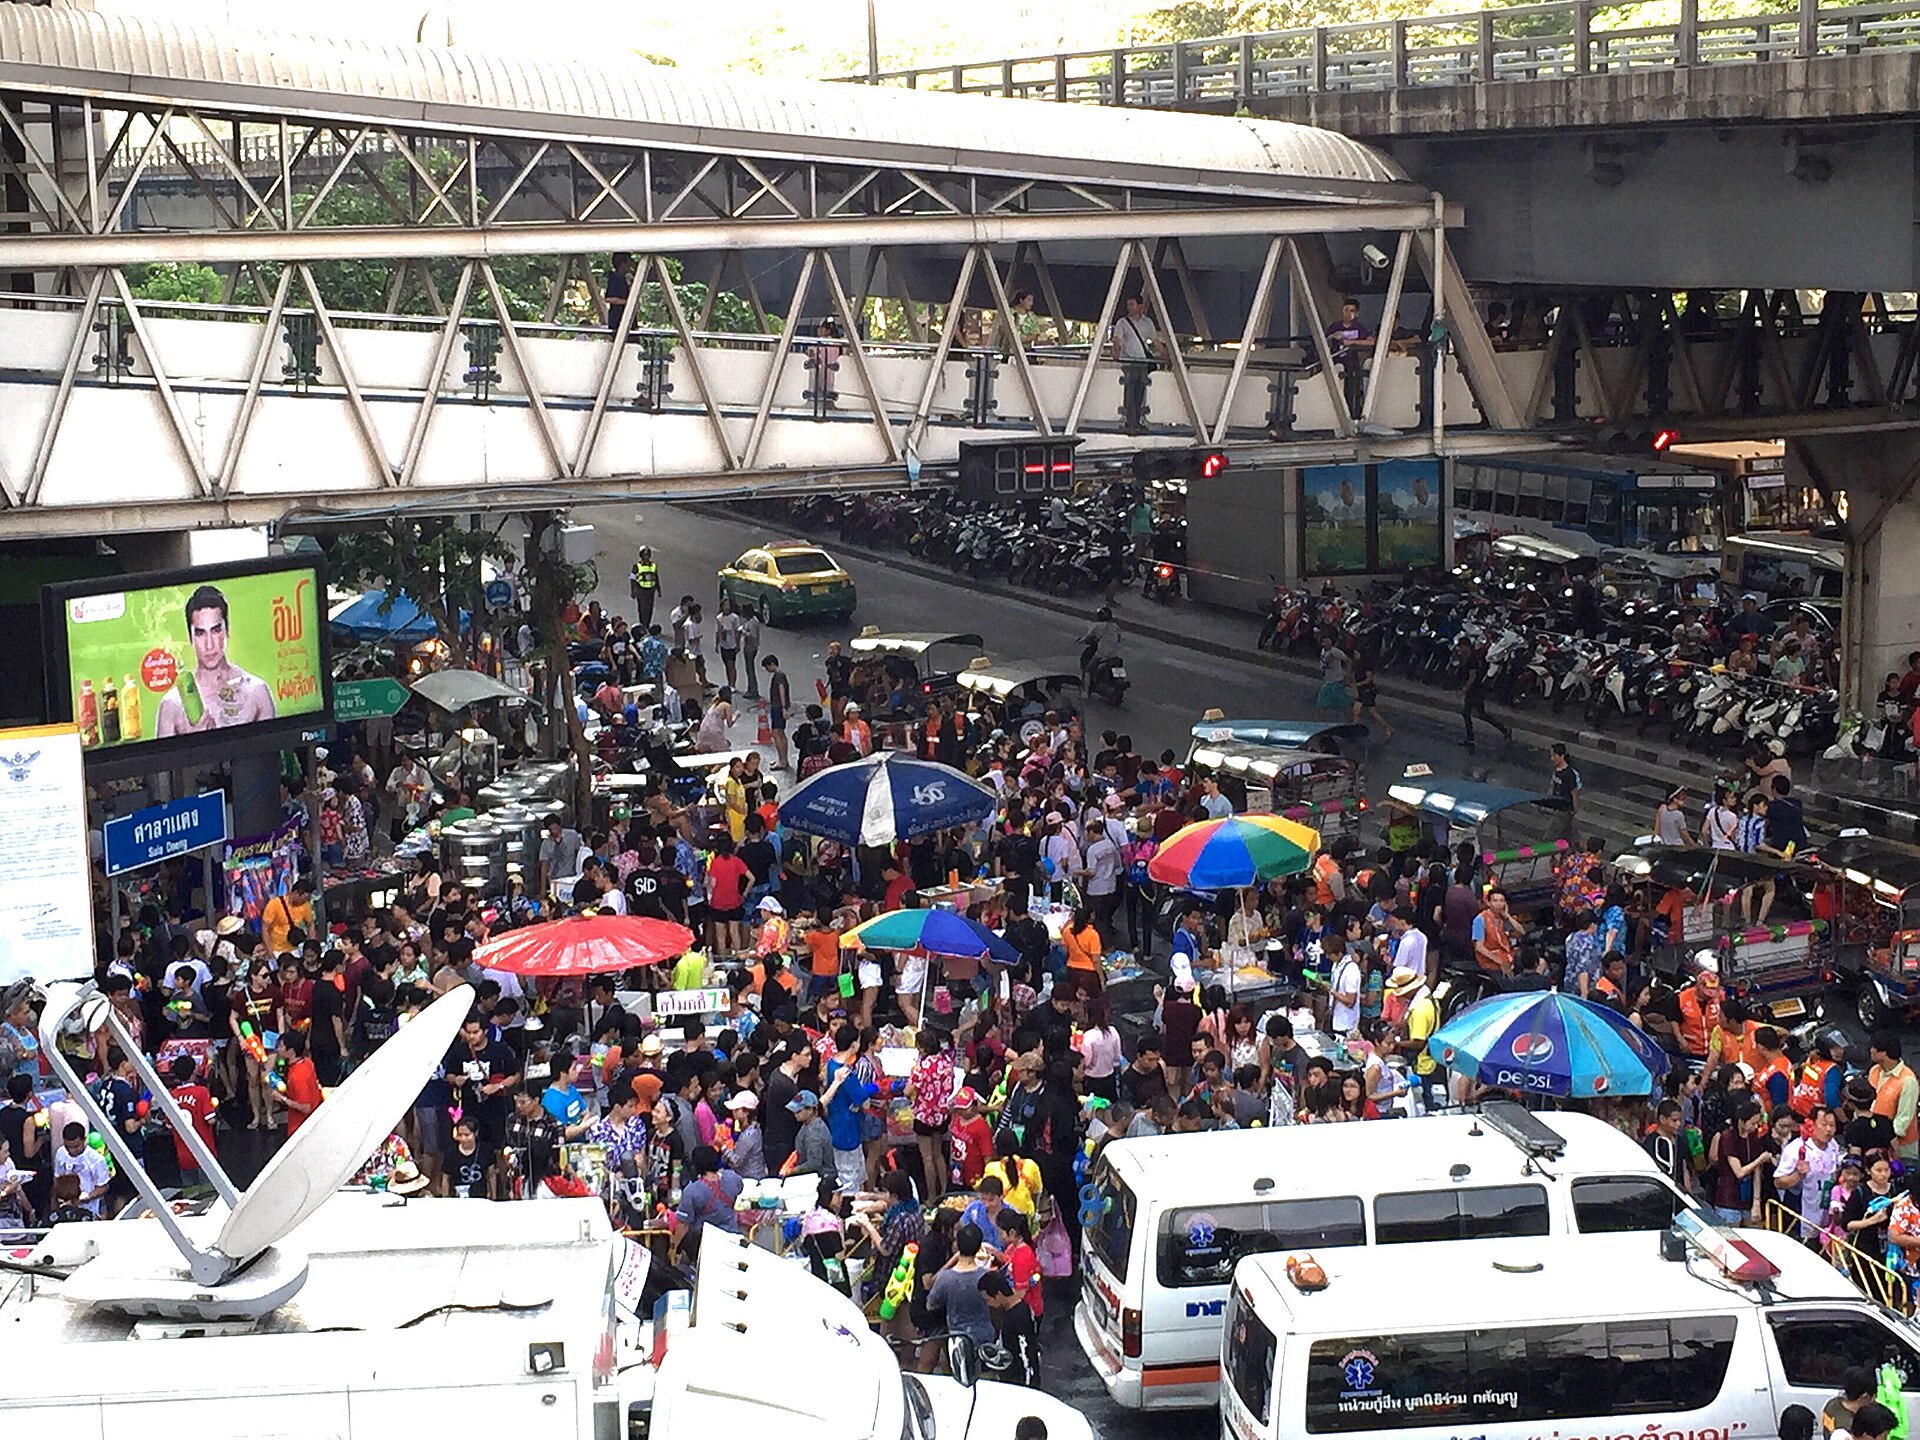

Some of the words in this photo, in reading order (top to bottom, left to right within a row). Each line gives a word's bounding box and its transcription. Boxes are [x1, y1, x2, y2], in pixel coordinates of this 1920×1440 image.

[134, 809, 199, 844] ศาลาแดง
[634, 876, 657, 895] SID
[707, 991, 717, 1009] 7
[1338, 1393, 1401, 1414] หน่วยกู้ชีพ
[1404, 1392, 1467, 1411] มูลนิธิร่วม
[1473, 1389, 1518, 1409] กตัญญู
